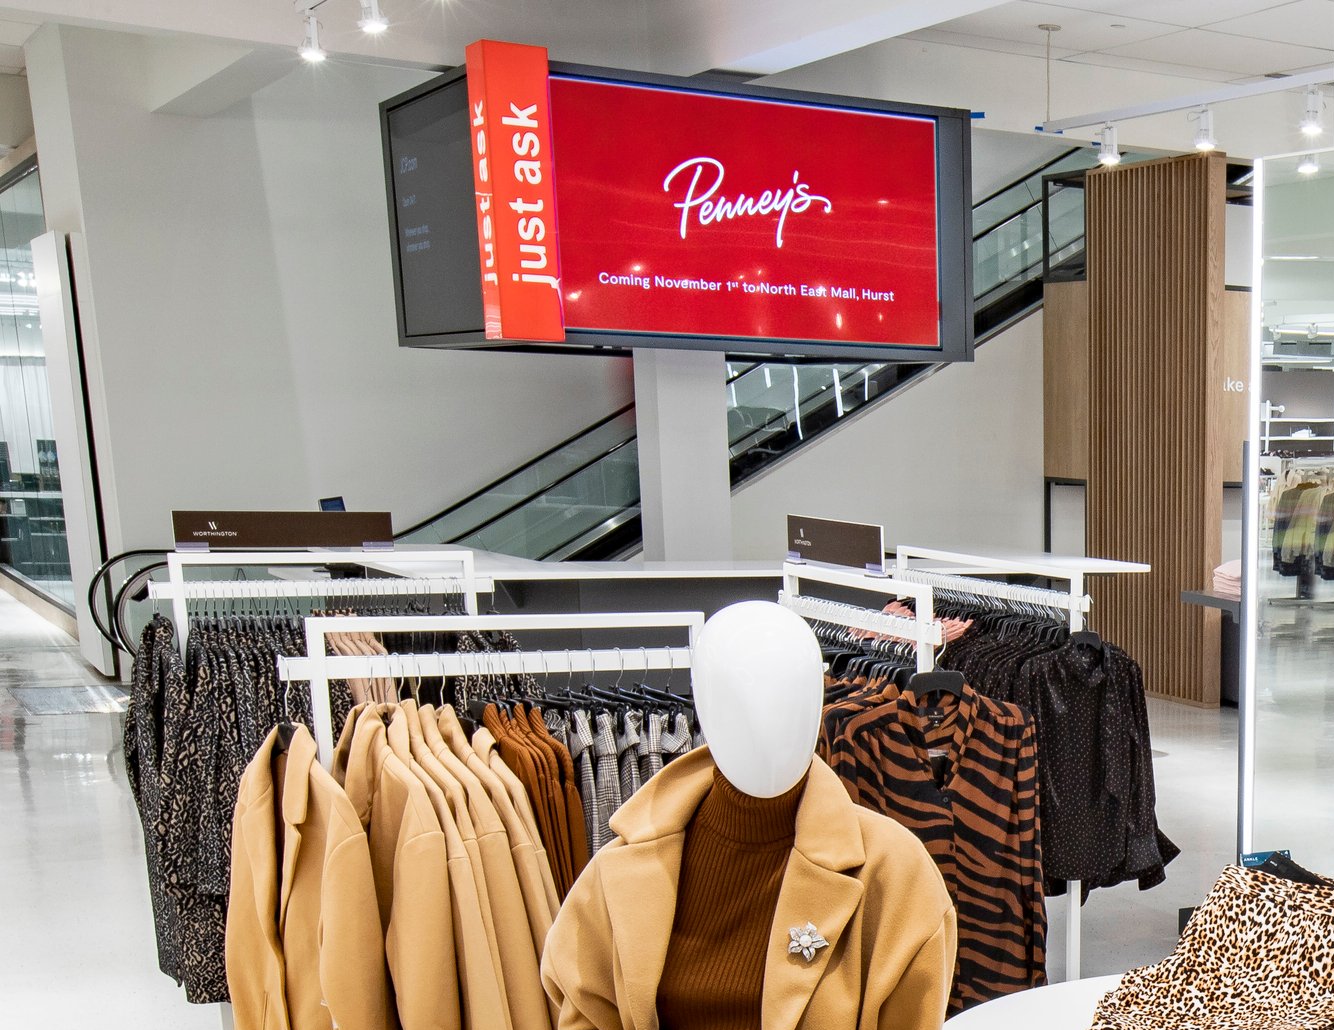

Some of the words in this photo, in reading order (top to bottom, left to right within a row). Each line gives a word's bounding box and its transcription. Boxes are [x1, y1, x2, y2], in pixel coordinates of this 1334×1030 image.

[473, 100, 488, 183] ask
[502, 102, 542, 185] ask
[479, 195, 498, 286] just
[508, 197, 559, 288] just
[663, 156, 832, 249] Penney's
[599, 272, 651, 290] Coming
[655, 275, 722, 291] November
[726, 280, 739, 292] 1st
[742, 282, 757, 293] to
[760, 282, 797, 296] North
[800, 284, 827, 298] East
[831, 287, 859, 301] Mall,
[862, 288, 895, 302] Hurst
